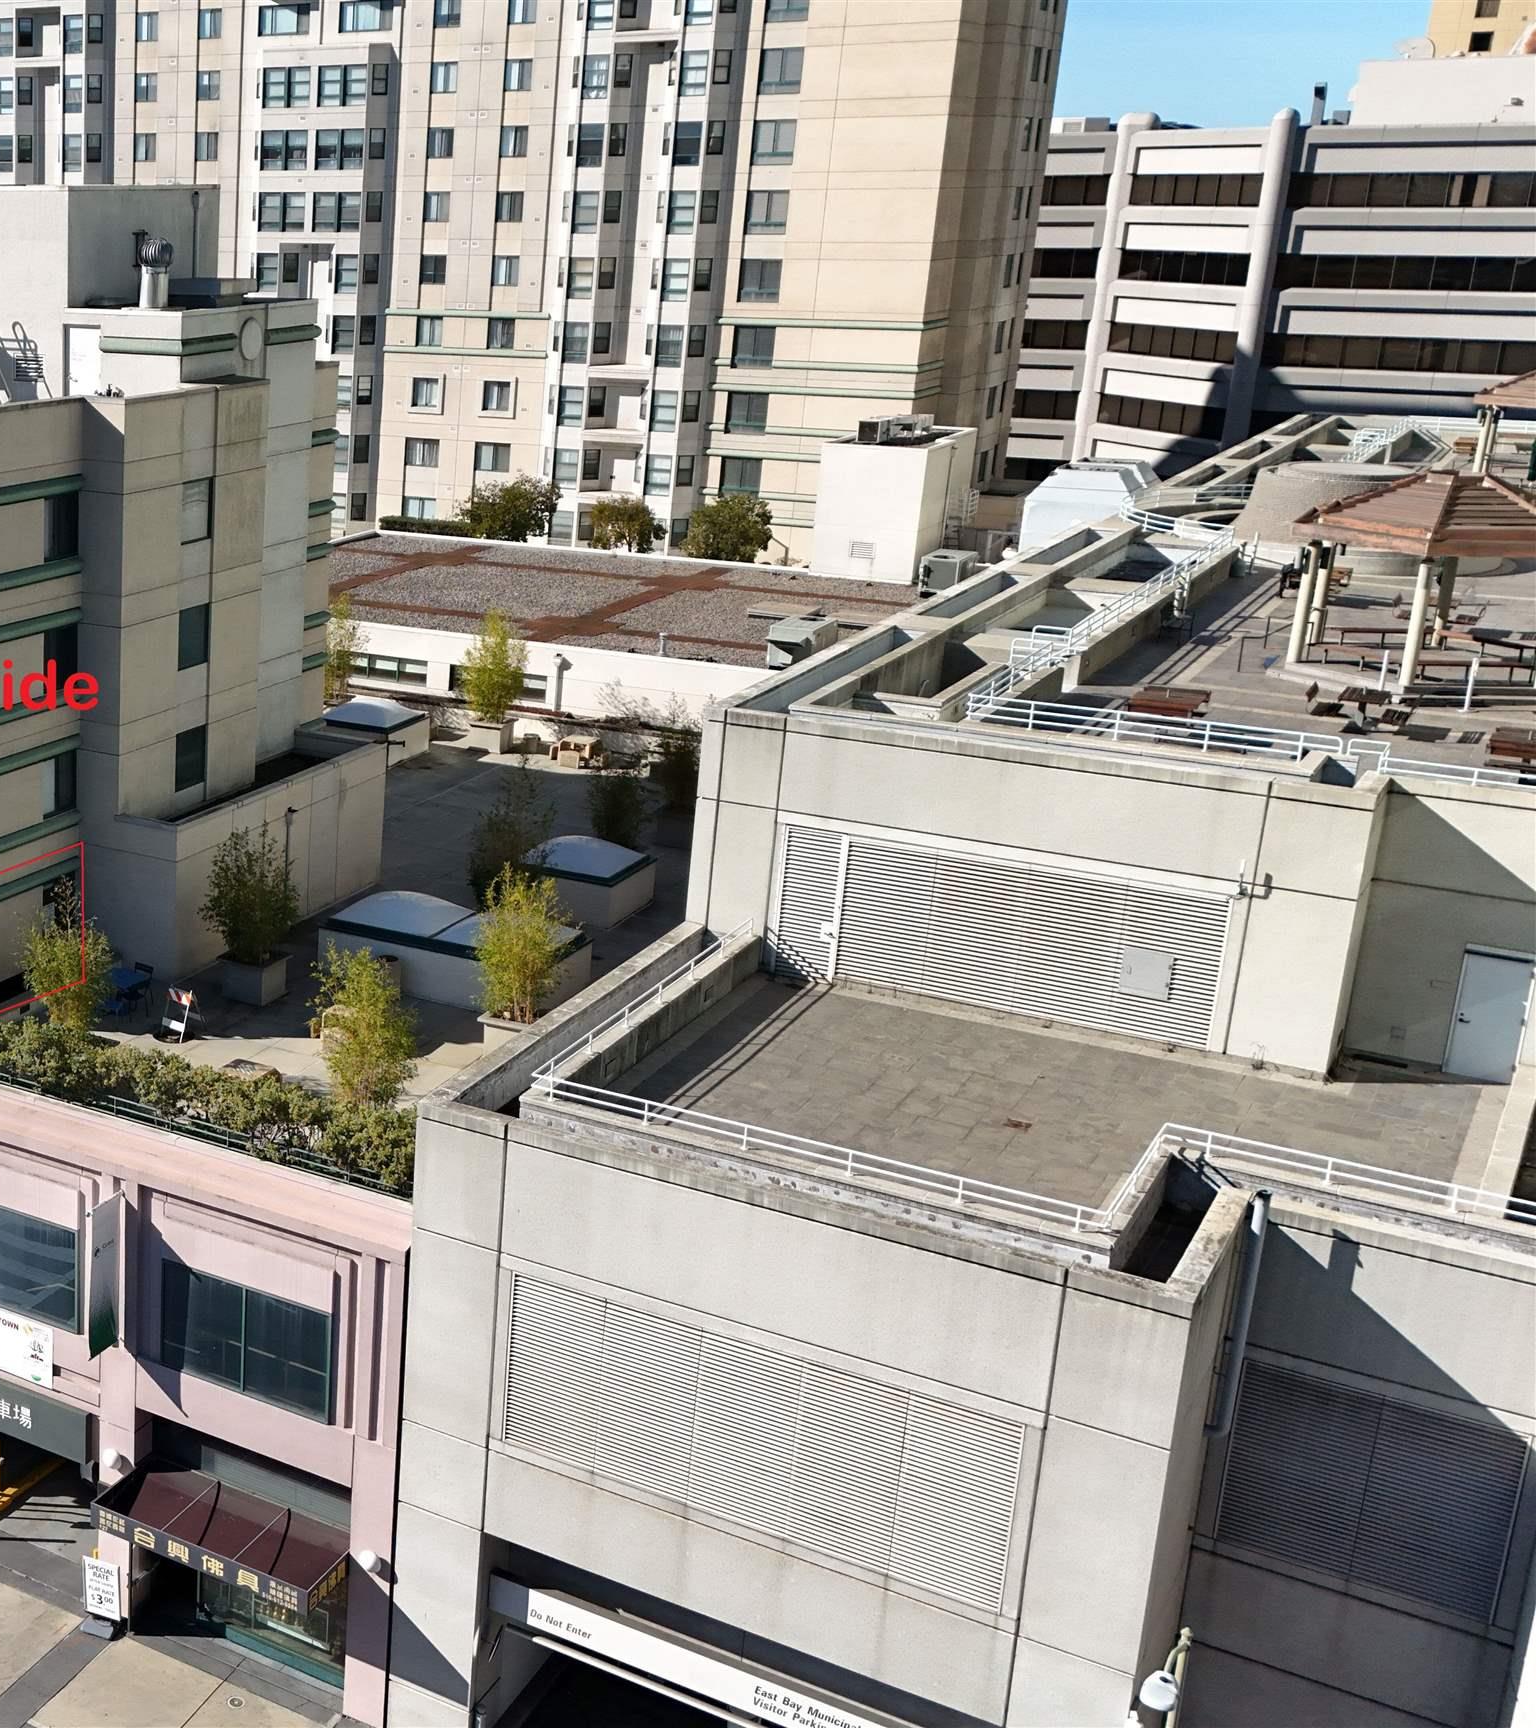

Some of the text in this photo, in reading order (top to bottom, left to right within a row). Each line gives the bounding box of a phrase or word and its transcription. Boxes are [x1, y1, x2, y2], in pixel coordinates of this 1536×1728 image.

[87, 1563, 115, 1577] SPECIAL
[92, 1571, 110, 1582] RATE
[101, 1588, 115, 1597] RATE
[530, 1608, 593, 1640] Do Not Enter
[753, 1695, 788, 1717] Visitor
[754, 1685, 862, 1728] East Bay Municip
